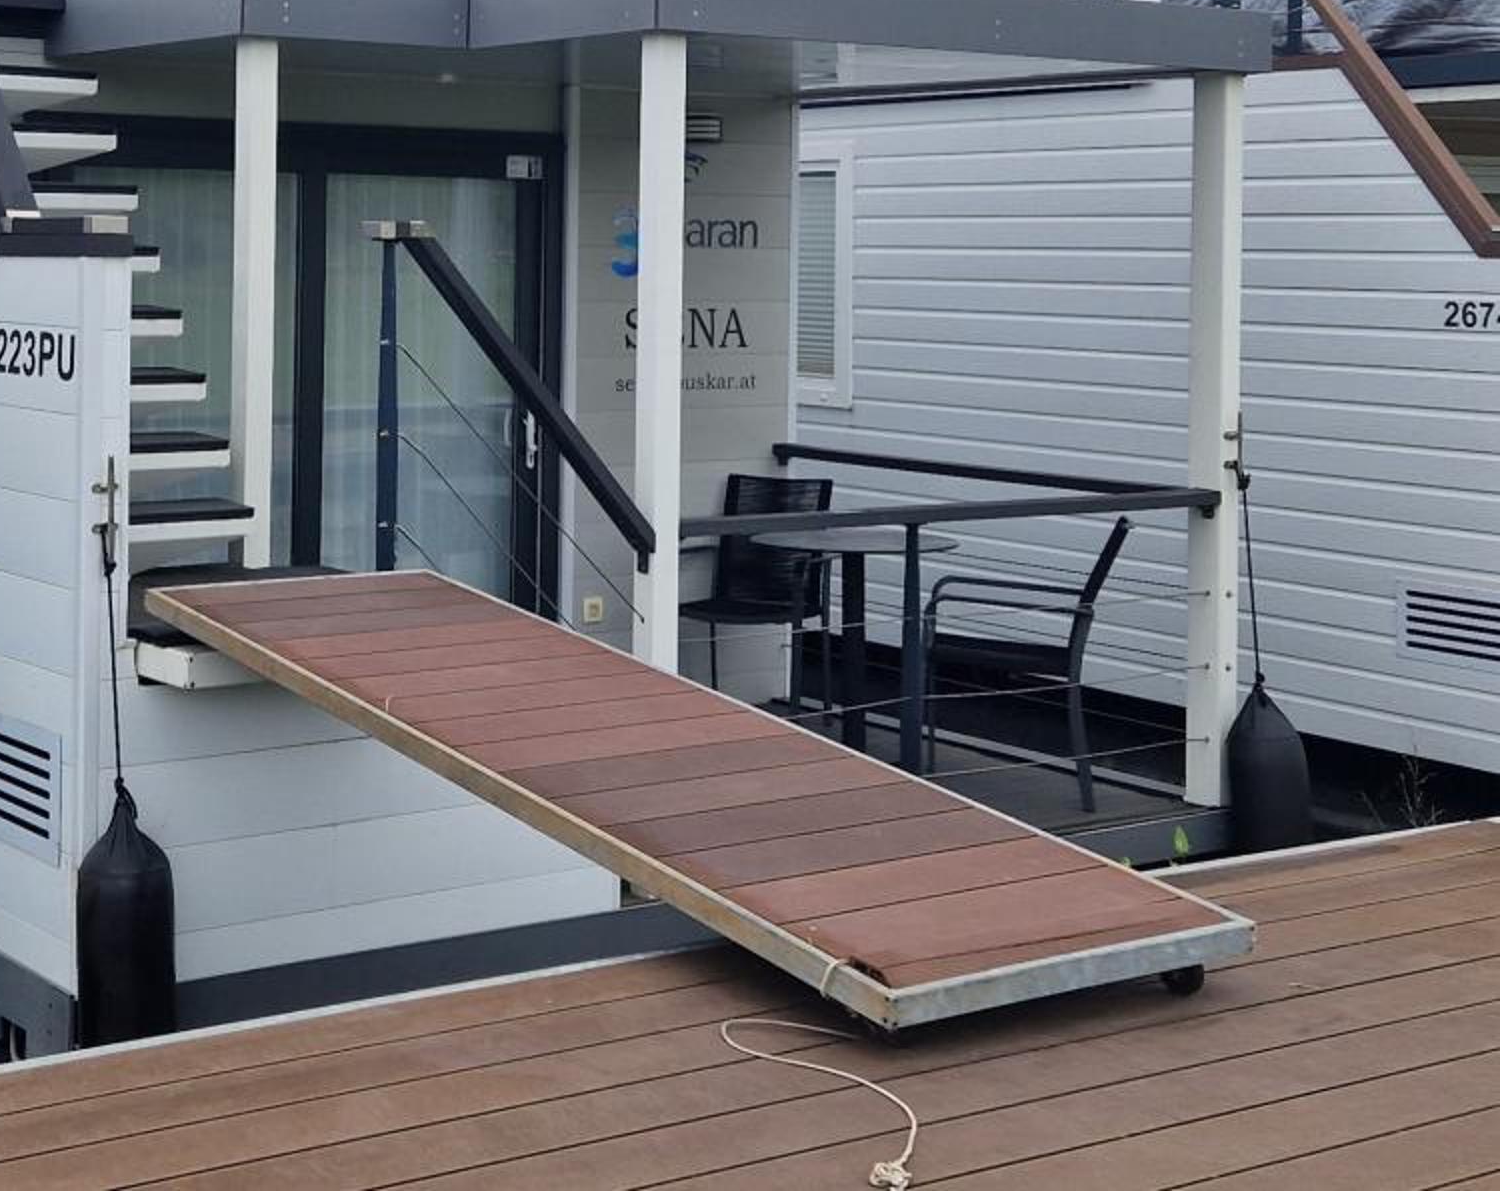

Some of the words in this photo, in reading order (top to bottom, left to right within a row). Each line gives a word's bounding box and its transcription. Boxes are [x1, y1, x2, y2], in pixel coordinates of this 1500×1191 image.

[684, 219, 759, 249] aran
[624, 308, 749, 350] SNA
[1444, 300, 1500, 329] 267
